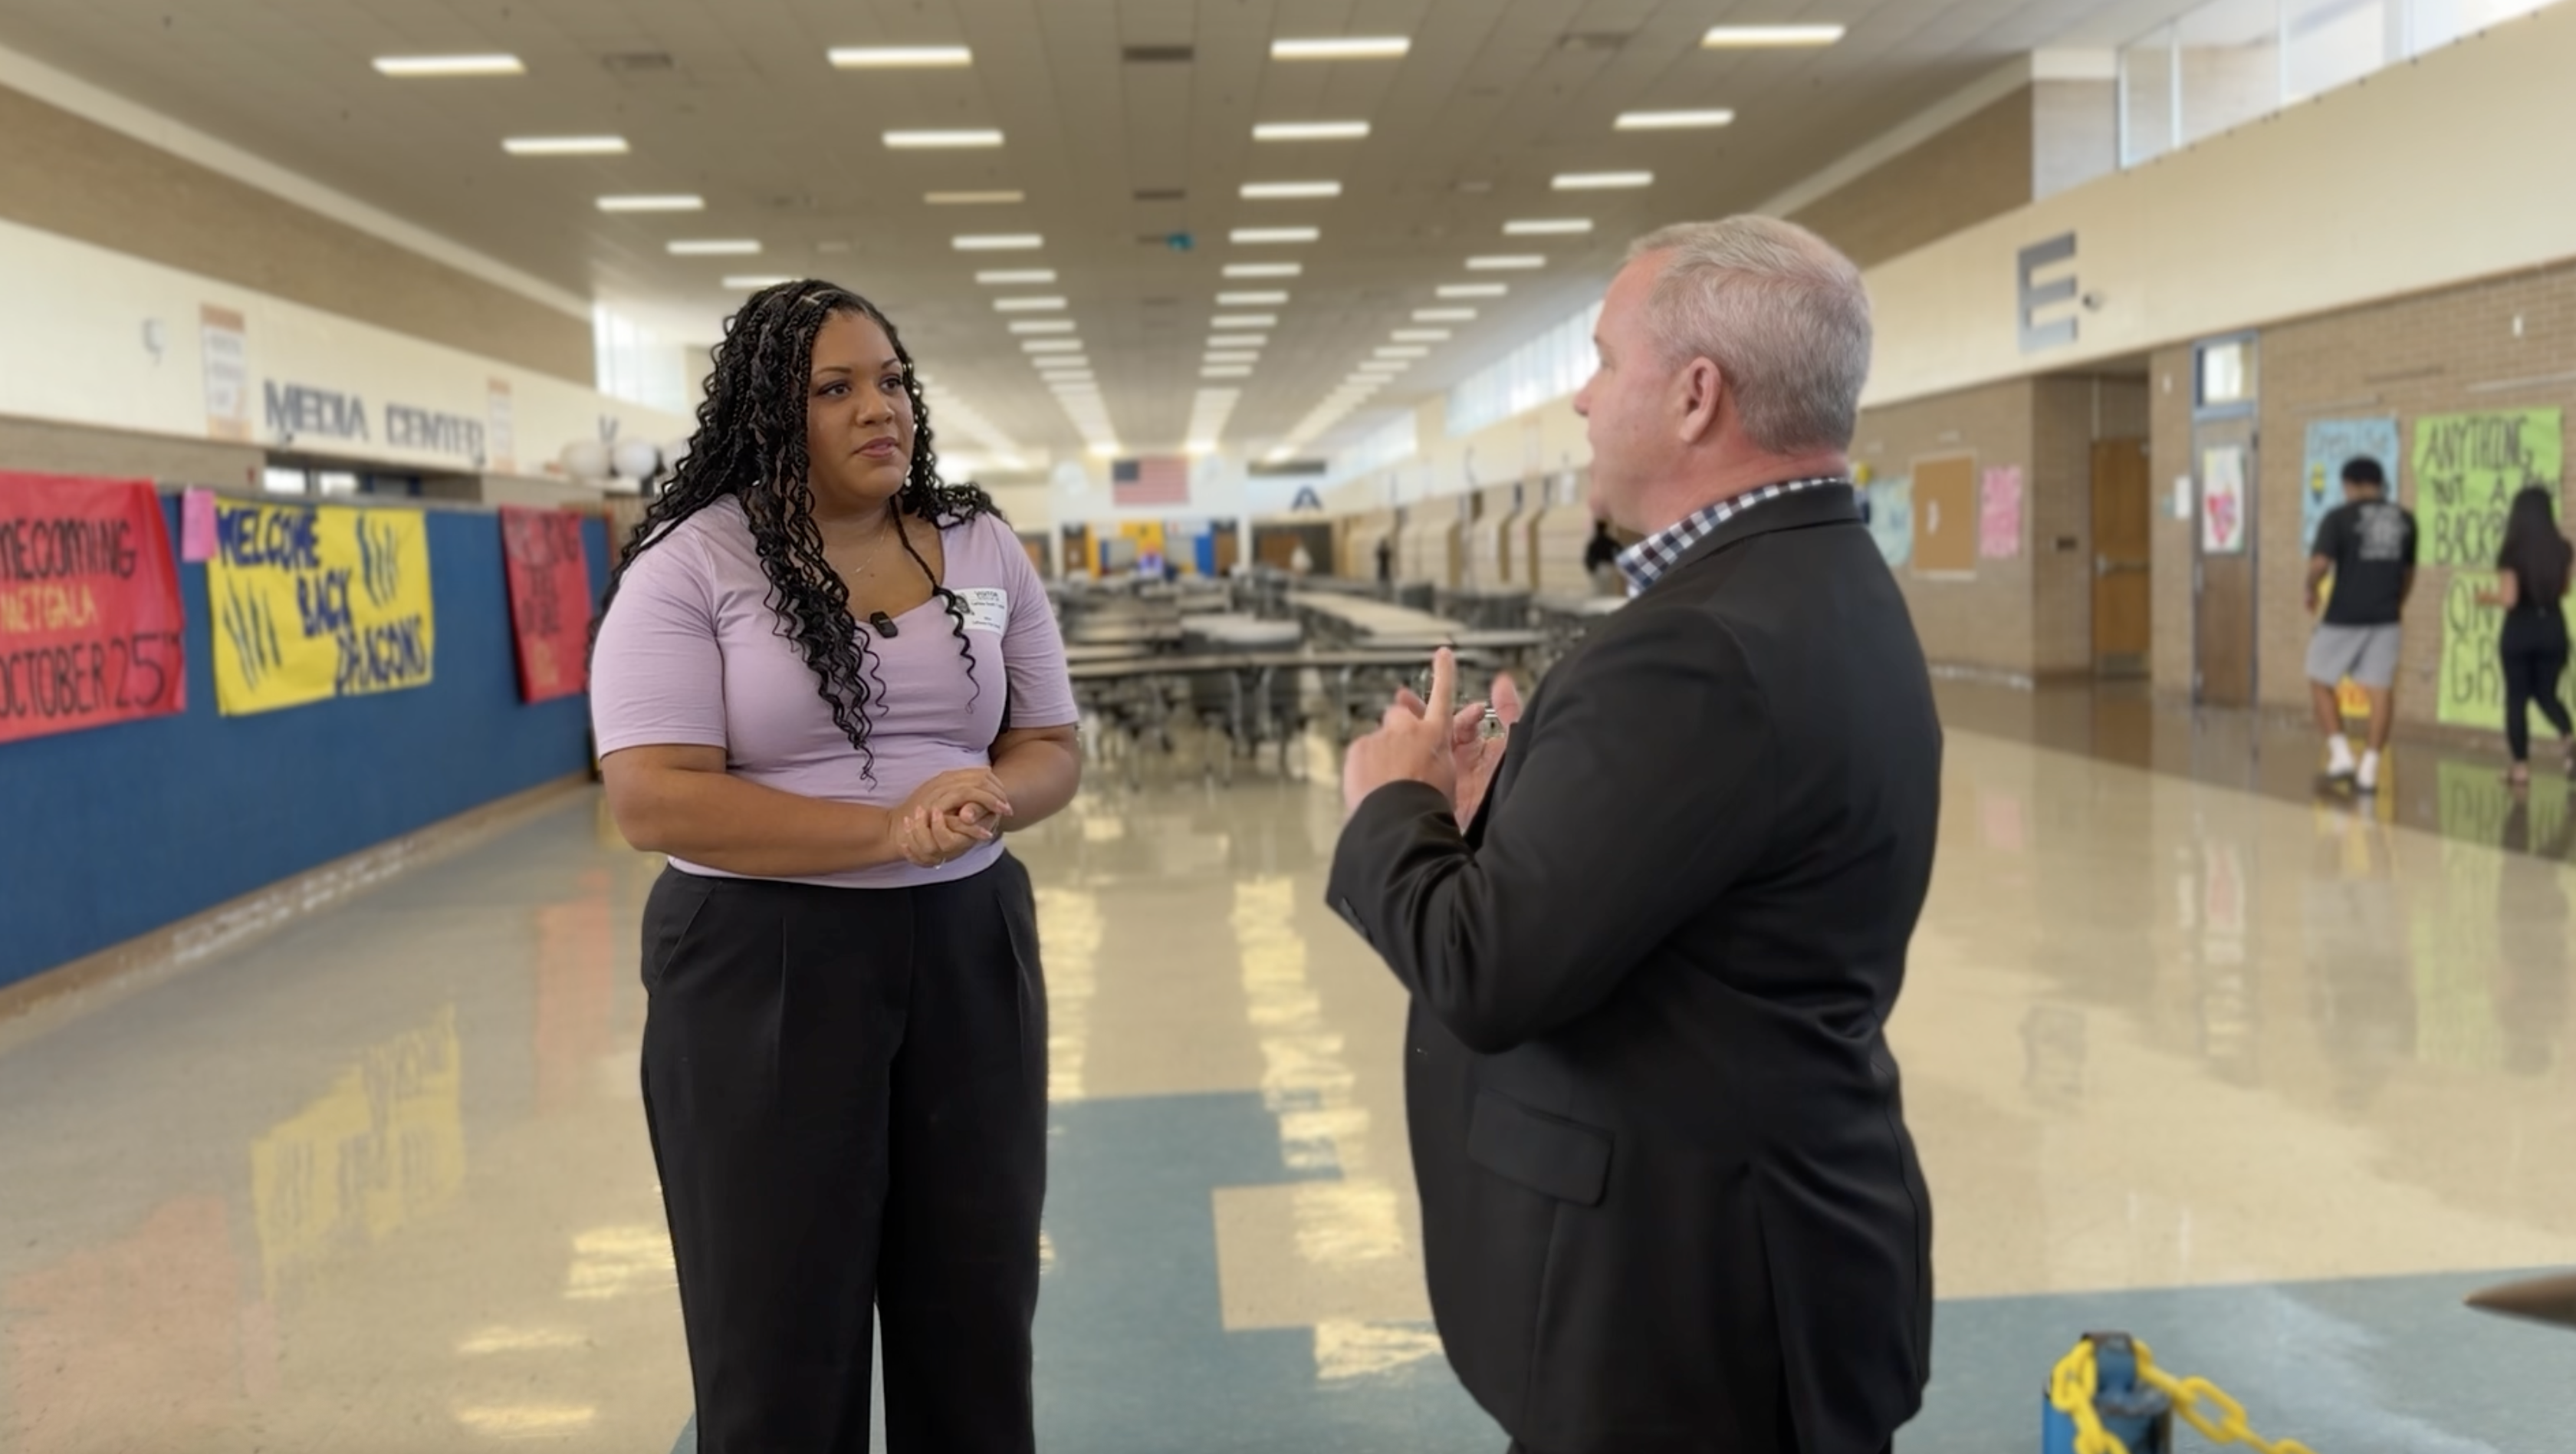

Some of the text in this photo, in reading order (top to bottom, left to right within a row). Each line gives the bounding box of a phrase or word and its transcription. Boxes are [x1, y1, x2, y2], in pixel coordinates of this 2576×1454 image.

[2018, 230, 2077, 354] E
[264, 379, 370, 442] MEDIA
[386, 401, 485, 458] CENTER
[217, 505, 320, 572] WELCOME
[297, 566, 353, 638] BACK
[335, 612, 426, 696] DRAGONS
